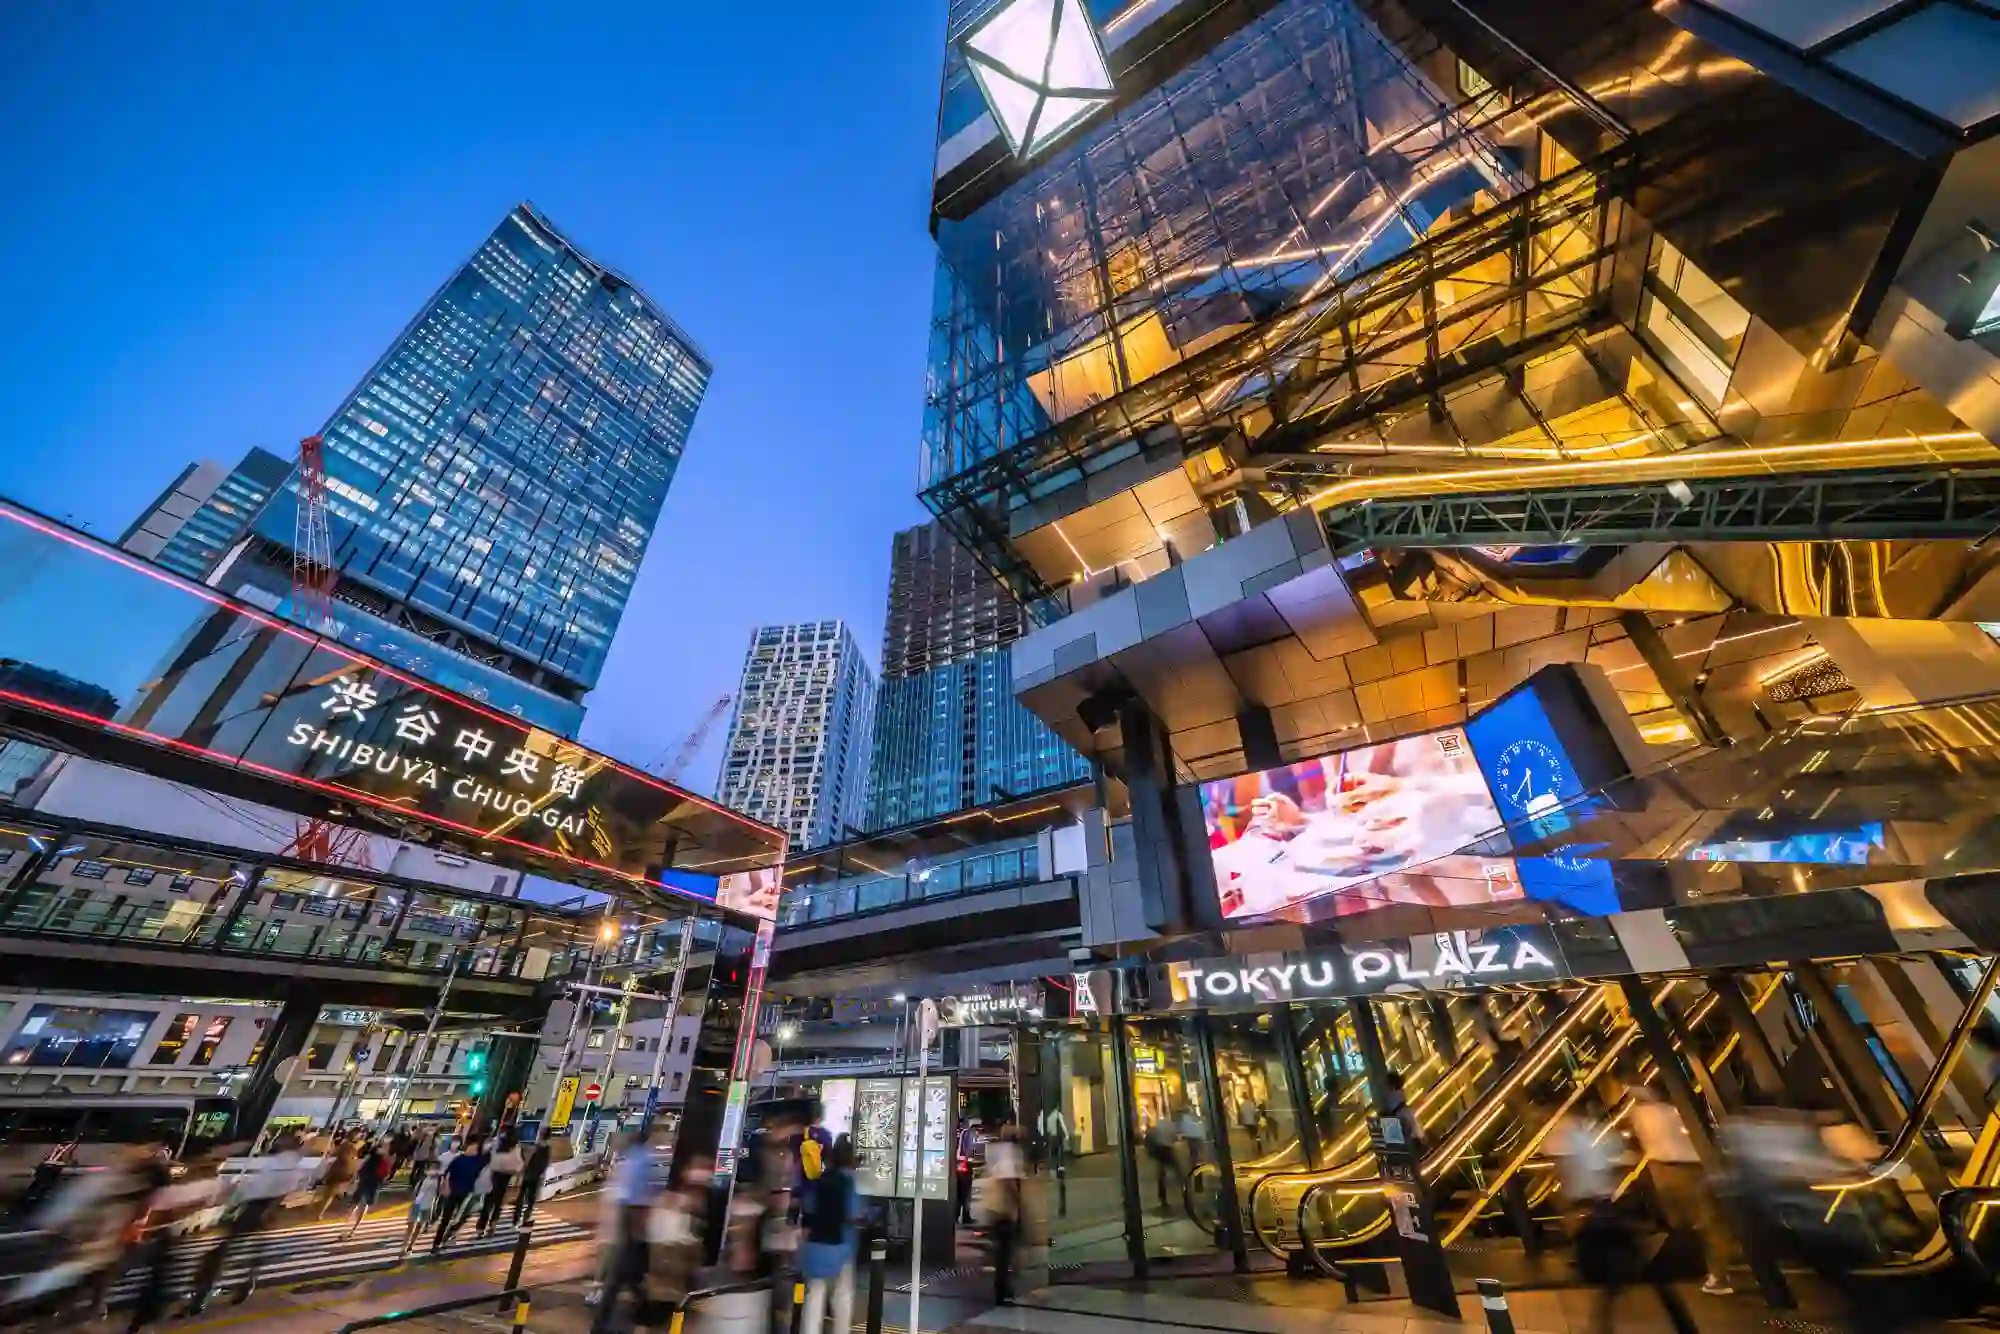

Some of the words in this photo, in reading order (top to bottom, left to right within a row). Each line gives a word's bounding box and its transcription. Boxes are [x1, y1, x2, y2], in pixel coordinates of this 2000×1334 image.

[287, 722, 438, 790] SHIBUYA
[452, 777, 585, 836] CHUO-GAI
[320, 675, 586, 800] 渋谷中央街
[1178, 961, 1334, 999] TOKYU
[1352, 941, 1555, 984] PLAZA
